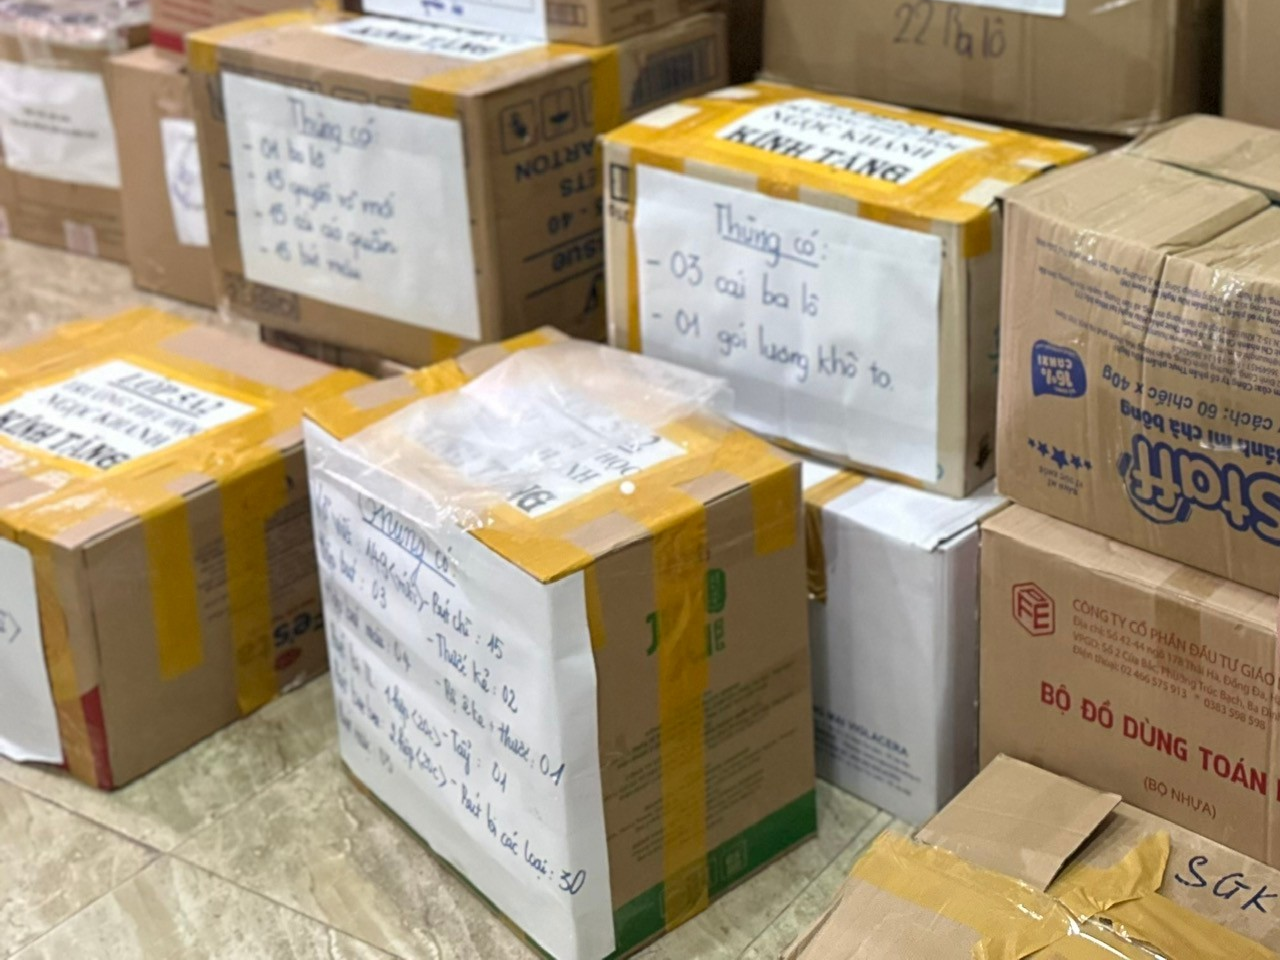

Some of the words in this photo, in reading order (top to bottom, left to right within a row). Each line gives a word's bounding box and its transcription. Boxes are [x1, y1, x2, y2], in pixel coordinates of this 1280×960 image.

[893, 0, 934, 46] 22
[982, 15, 1007, 60] lô
[726, 124, 817, 159] KÍNH
[713, 201, 782, 268] Thùng
[670, 250, 704, 287] 03
[714, 269, 748, 301] cái
[762, 273, 790, 310] ba
[801, 282, 820, 319] lô
[675, 309, 701, 337] 01
[717, 320, 748, 358] gói
[817, 345, 859, 380] khô
[1101, 363, 1130, 391] 40g
[1136, 382, 1144, 396] x
[1146, 383, 1193, 412] chiếc
[1197, 400, 1218, 424] 60
[0, 408, 63, 444] KÍNH
[1119, 398, 1165, 434] bông
[1166, 419, 1203, 445] chà
[1222, 408, 1273, 435] cách:
[487, 633, 505, 660] 15
[1072, 598, 1110, 624] CÔNG
[1111, 610, 1128, 628] TY
[1129, 616, 1148, 637] CỔ
[1150, 626, 1188, 653] PHẦN
[1189, 638, 1219, 665] ĐẦU
[1220, 652, 1239, 672] TƯ
[1241, 660, 1277, 687] GIÁO
[1106, 623, 1119, 640] Số
[1119, 634, 1146, 653] 42-44
[1167, 649, 1186, 668] 178
[1223, 673, 1251, 698] Đống
[1252, 683, 1268, 703] Đa,
[1121, 648, 1140, 667] Cửa
[1160, 663, 1198, 691] Phường
[1198, 674, 1220, 696] Trúc
[1247, 698, 1260, 714] Ba
[501, 684, 519, 715] 02
[1072, 642, 1094, 661] Điện
[1120, 661, 1133, 676] 02
[1133, 667, 1152, 685] 466
[1152, 676, 1170, 693] 575
[1170, 683, 1188, 700] 913
[1203, 697, 1229, 717] 0383
[1229, 708, 1247, 726] 598
[1248, 713, 1267, 732] 598
[1040, 679, 1072, 717] BỘ
[1079, 699, 1115, 731] ĐỒ
[1122, 713, 1189, 763] DÙNG
[1198, 744, 1268, 798] TOÁN
[491, 760, 508, 794] 01
[539, 753, 567, 787] 01
[1170, 786, 1218, 821] NHỰA)
[500, 830, 519, 856] các
[558, 868, 587, 896] 30
[1174, 854, 1279, 916] SGK
